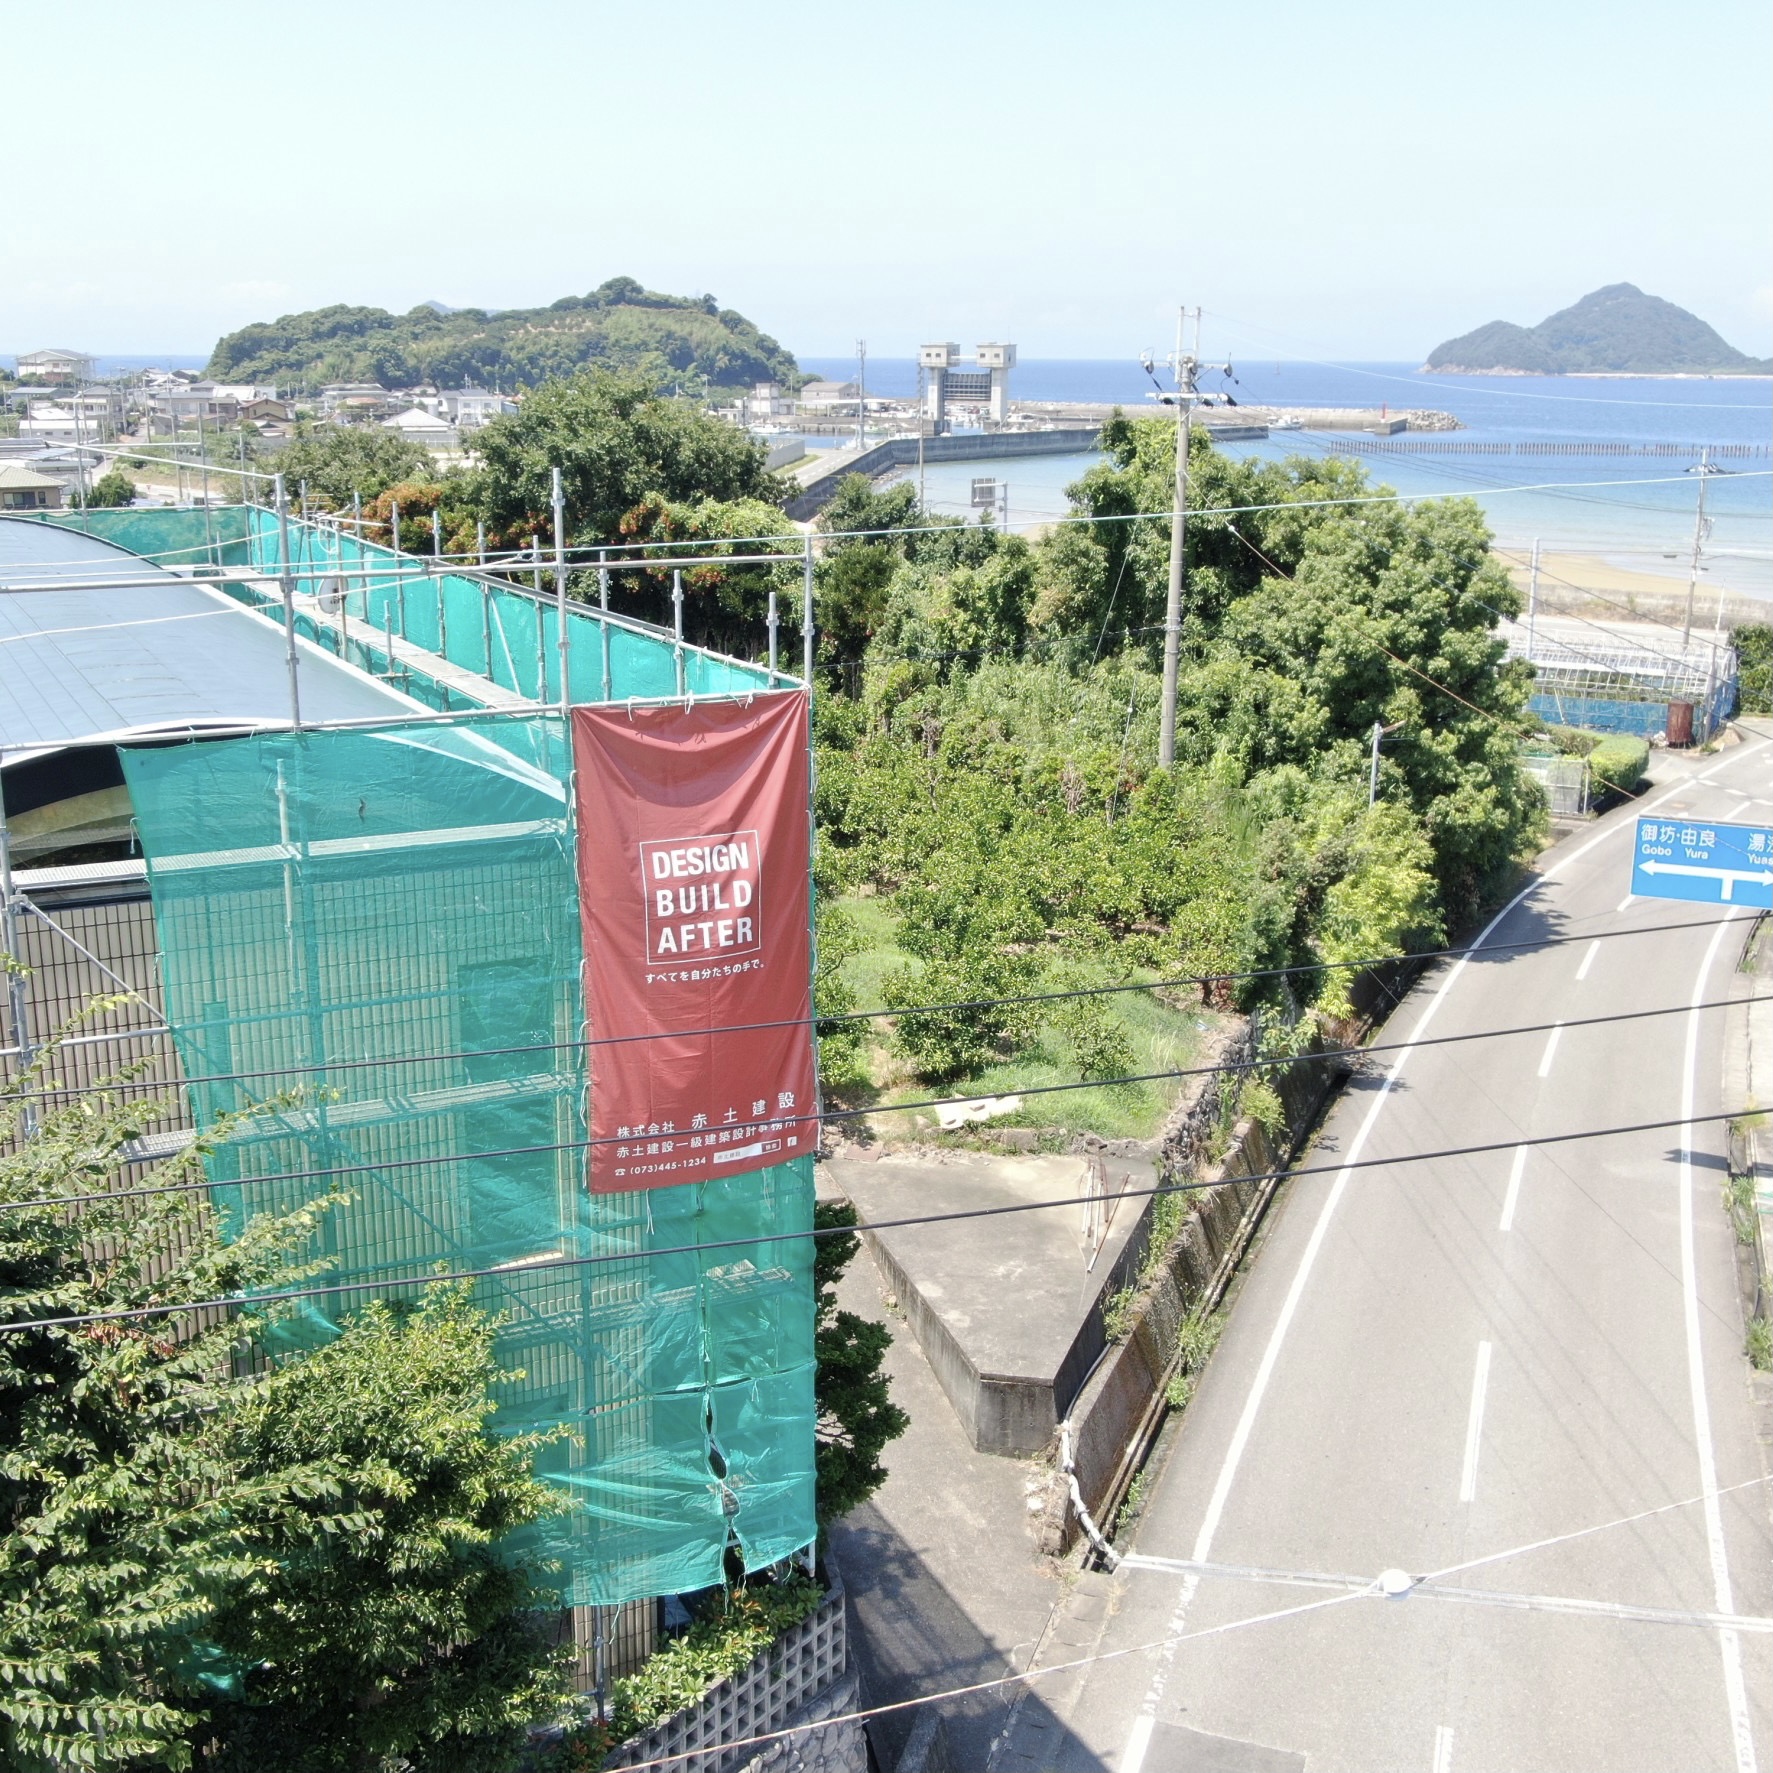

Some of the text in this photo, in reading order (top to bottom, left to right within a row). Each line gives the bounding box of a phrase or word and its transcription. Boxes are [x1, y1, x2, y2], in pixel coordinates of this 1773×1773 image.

[652, 842, 749, 879] DESIGN
[1641, 844, 1709, 860] Gobo Yura
[656, 879, 752, 917] BUILD
[657, 916, 753, 954] AFTER
[645, 958, 765, 984] すべてを自分たちの手で。
[616, 1091, 795, 1139] 株式会社 赤土建設
[630, 1156, 706, 1175] (073)445-1234
